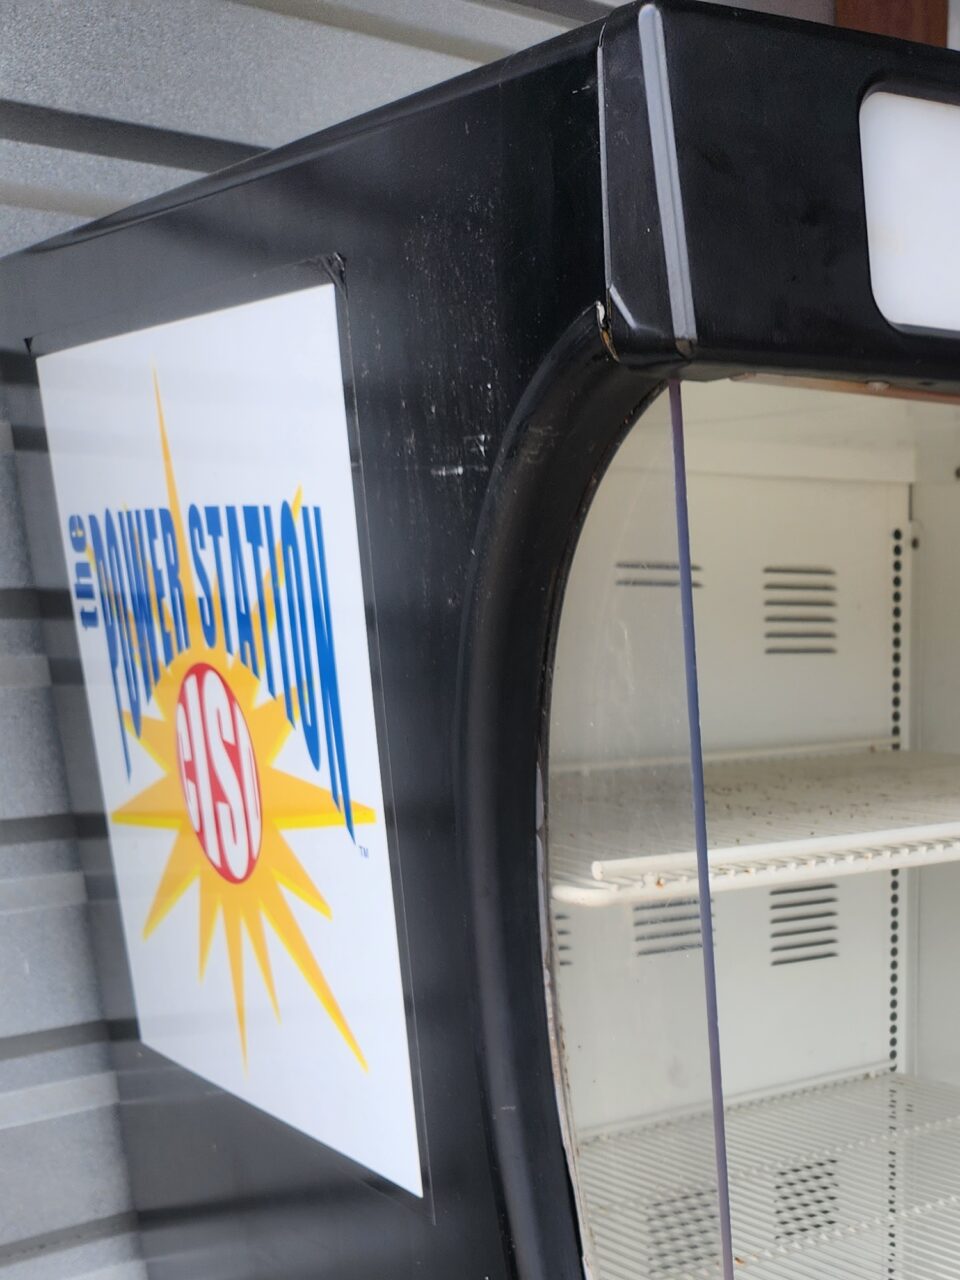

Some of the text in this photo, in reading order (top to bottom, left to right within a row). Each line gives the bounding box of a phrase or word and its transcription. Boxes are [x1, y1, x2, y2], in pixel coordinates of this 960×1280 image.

[68, 515, 99, 630] the
[88, 500, 356, 845] POWER STATION
